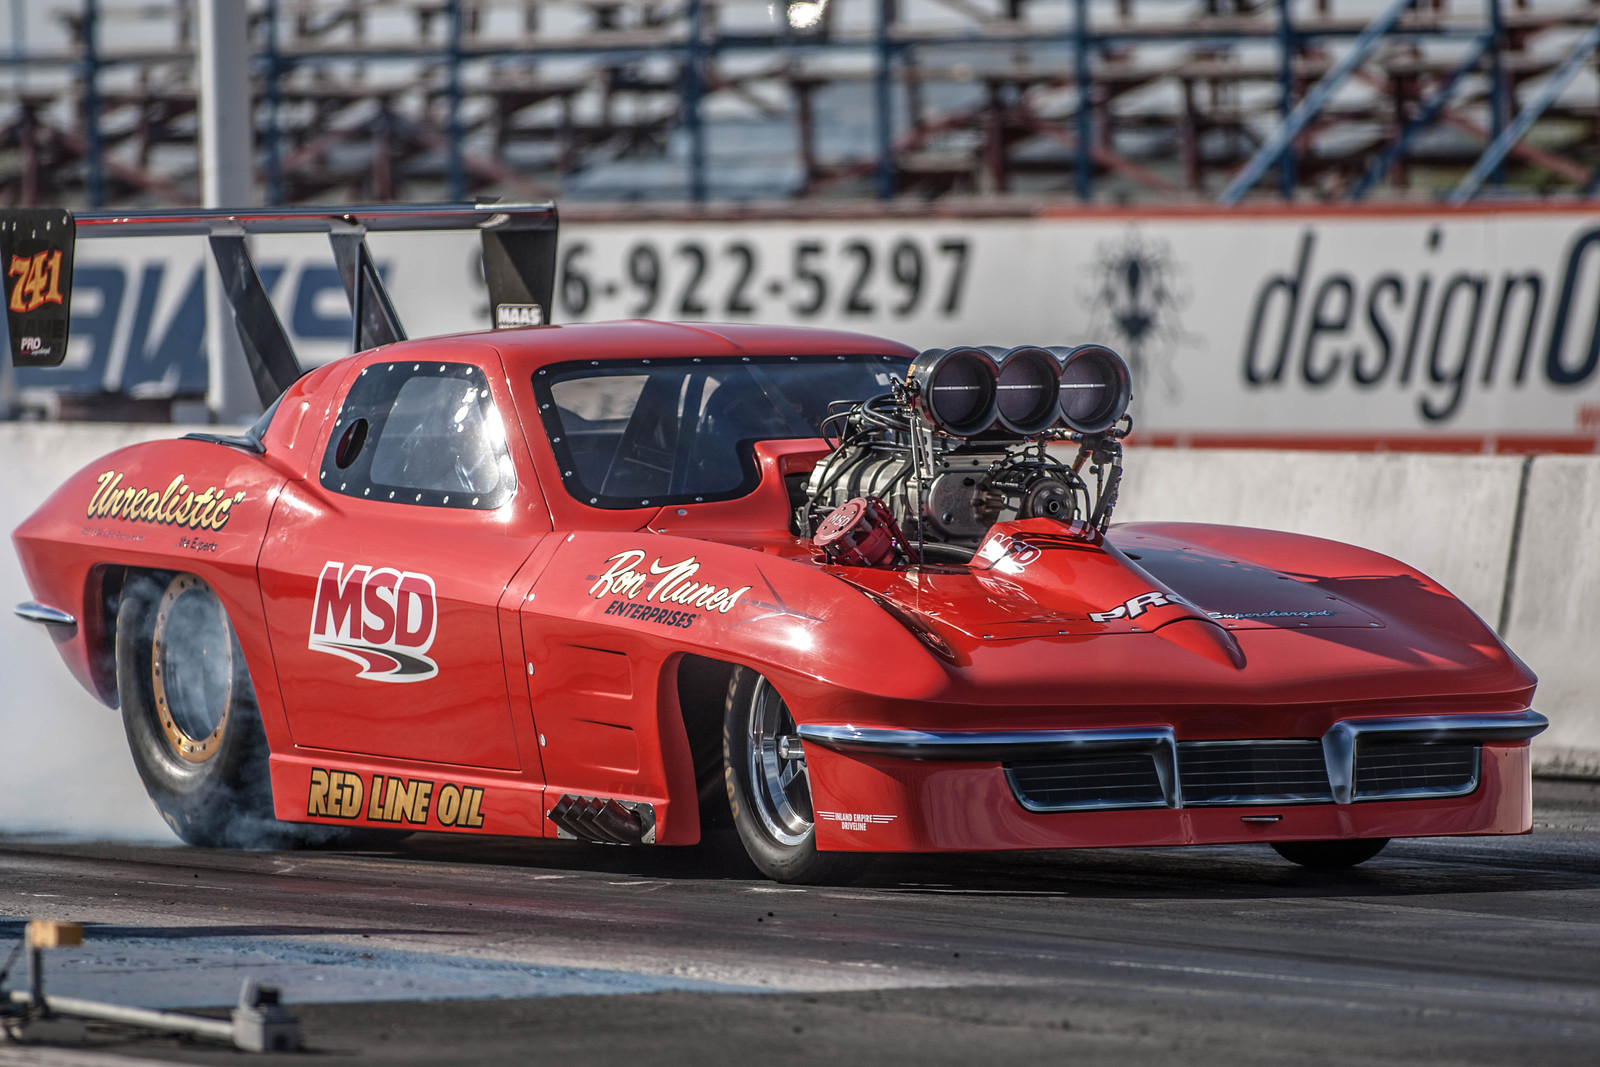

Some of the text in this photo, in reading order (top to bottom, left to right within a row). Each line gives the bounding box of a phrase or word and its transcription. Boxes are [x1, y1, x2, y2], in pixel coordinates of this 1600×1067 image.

[9, 250, 63, 312] 741
[468, 240, 974, 318] 6-922-5297
[498, 307, 541, 325] MAAS
[21, 337, 41, 351] PRO
[828, 513, 850, 527] MSD
[589, 549, 754, 614] Ron Nunes
[309, 561, 437, 648] MSD
[604, 600, 697, 629] ENTERPRISES
[1206, 610, 1333, 620] Supercharged
[307, 766, 485, 829] RED LINE OIL
[834, 812, 873, 823] INLAND EMPIRE
[841, 821, 867, 831] DRIVELINE
